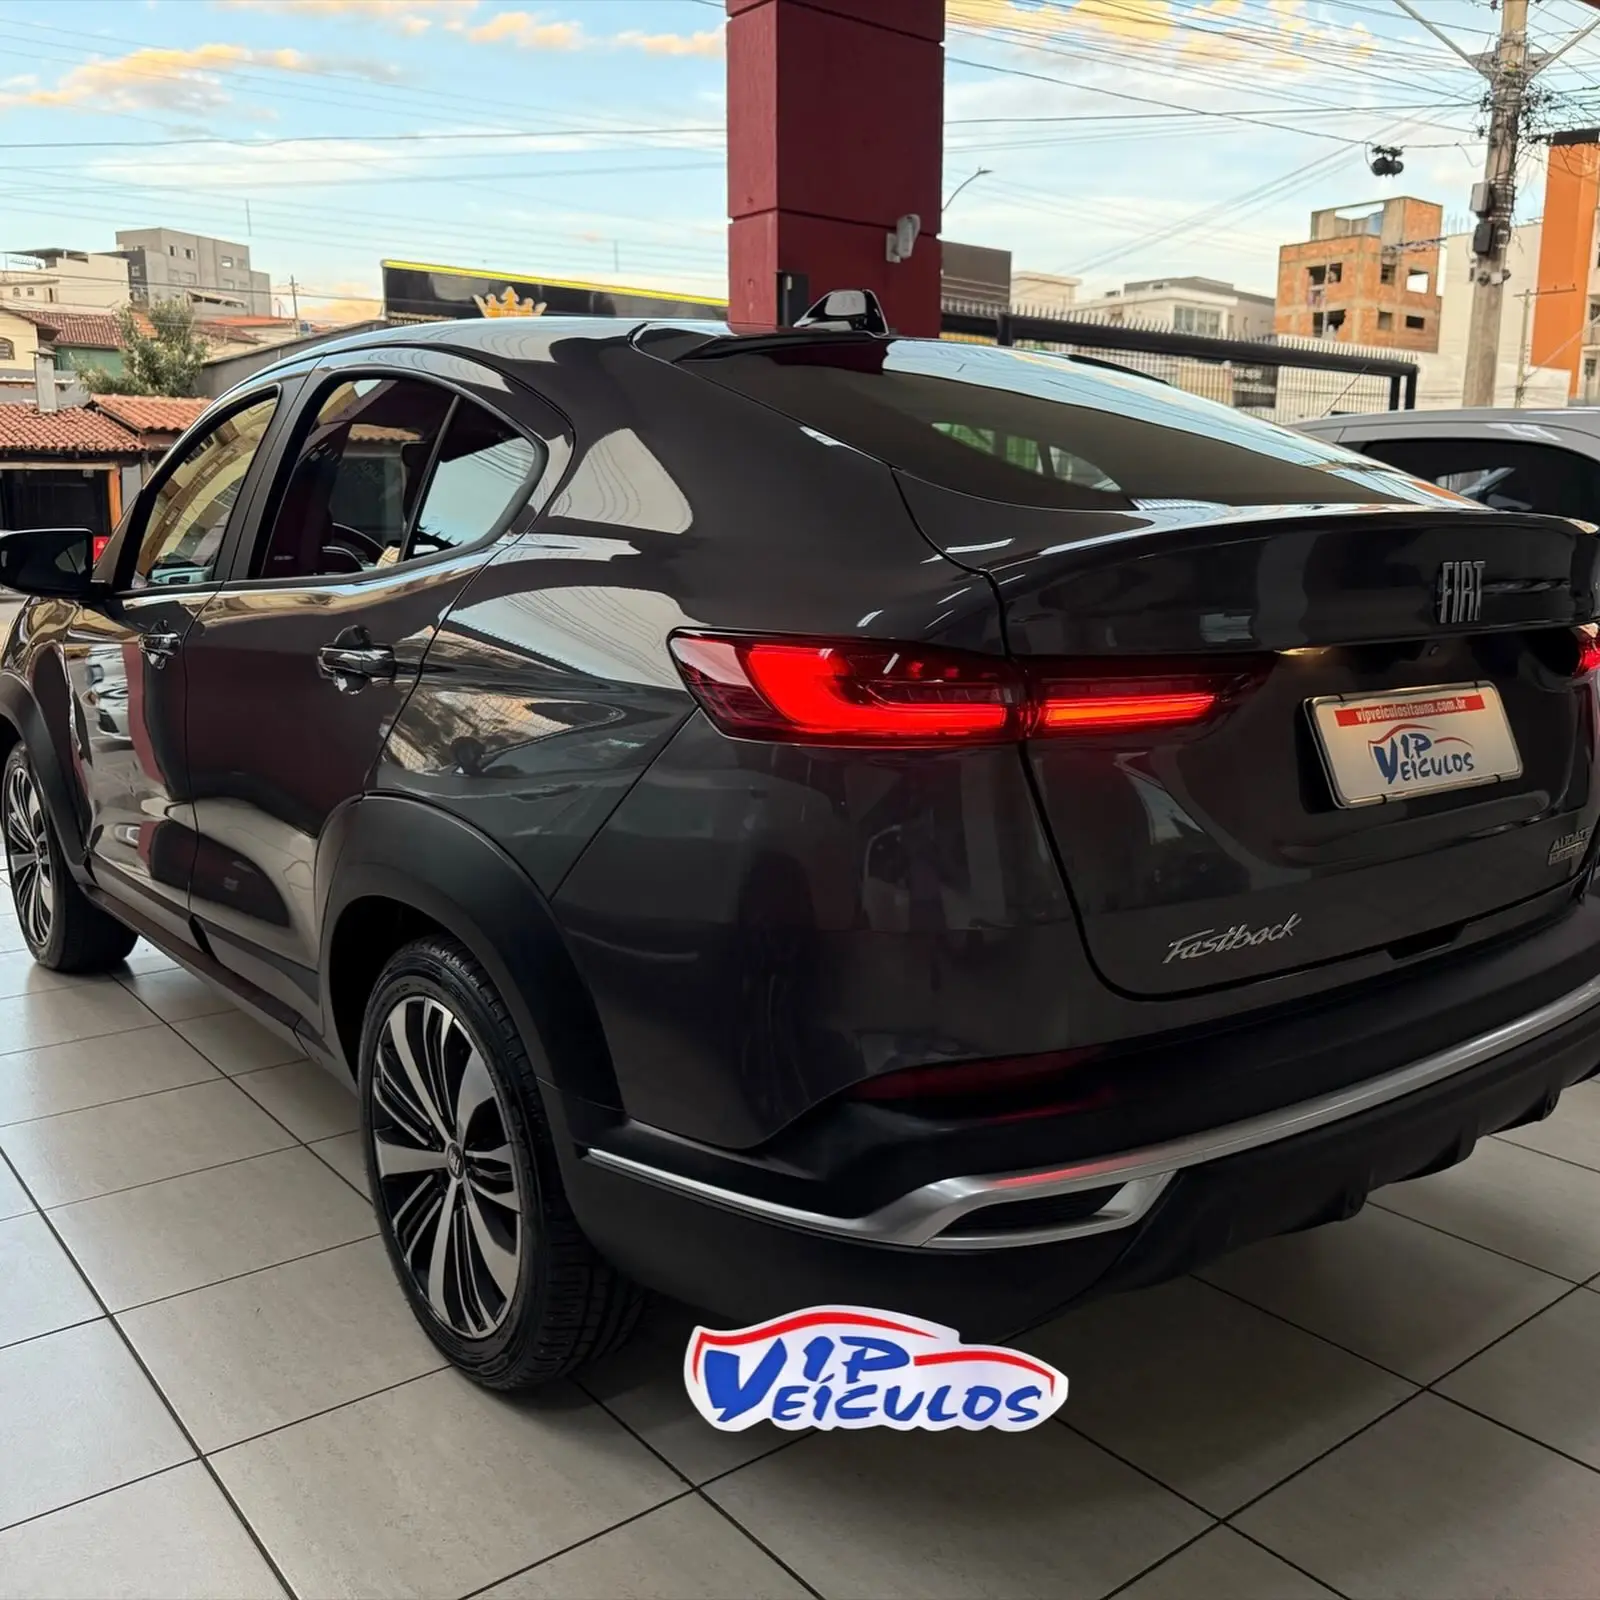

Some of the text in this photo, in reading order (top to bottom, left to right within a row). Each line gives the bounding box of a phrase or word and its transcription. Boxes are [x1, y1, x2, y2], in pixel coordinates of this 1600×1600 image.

[1440, 560, 1486, 624] FIAT
[1355, 697, 1467, 724] vipveiculositauna.com.br
[1373, 732, 1432, 785] VIP
[1161, 912, 1302, 964] Fastback
